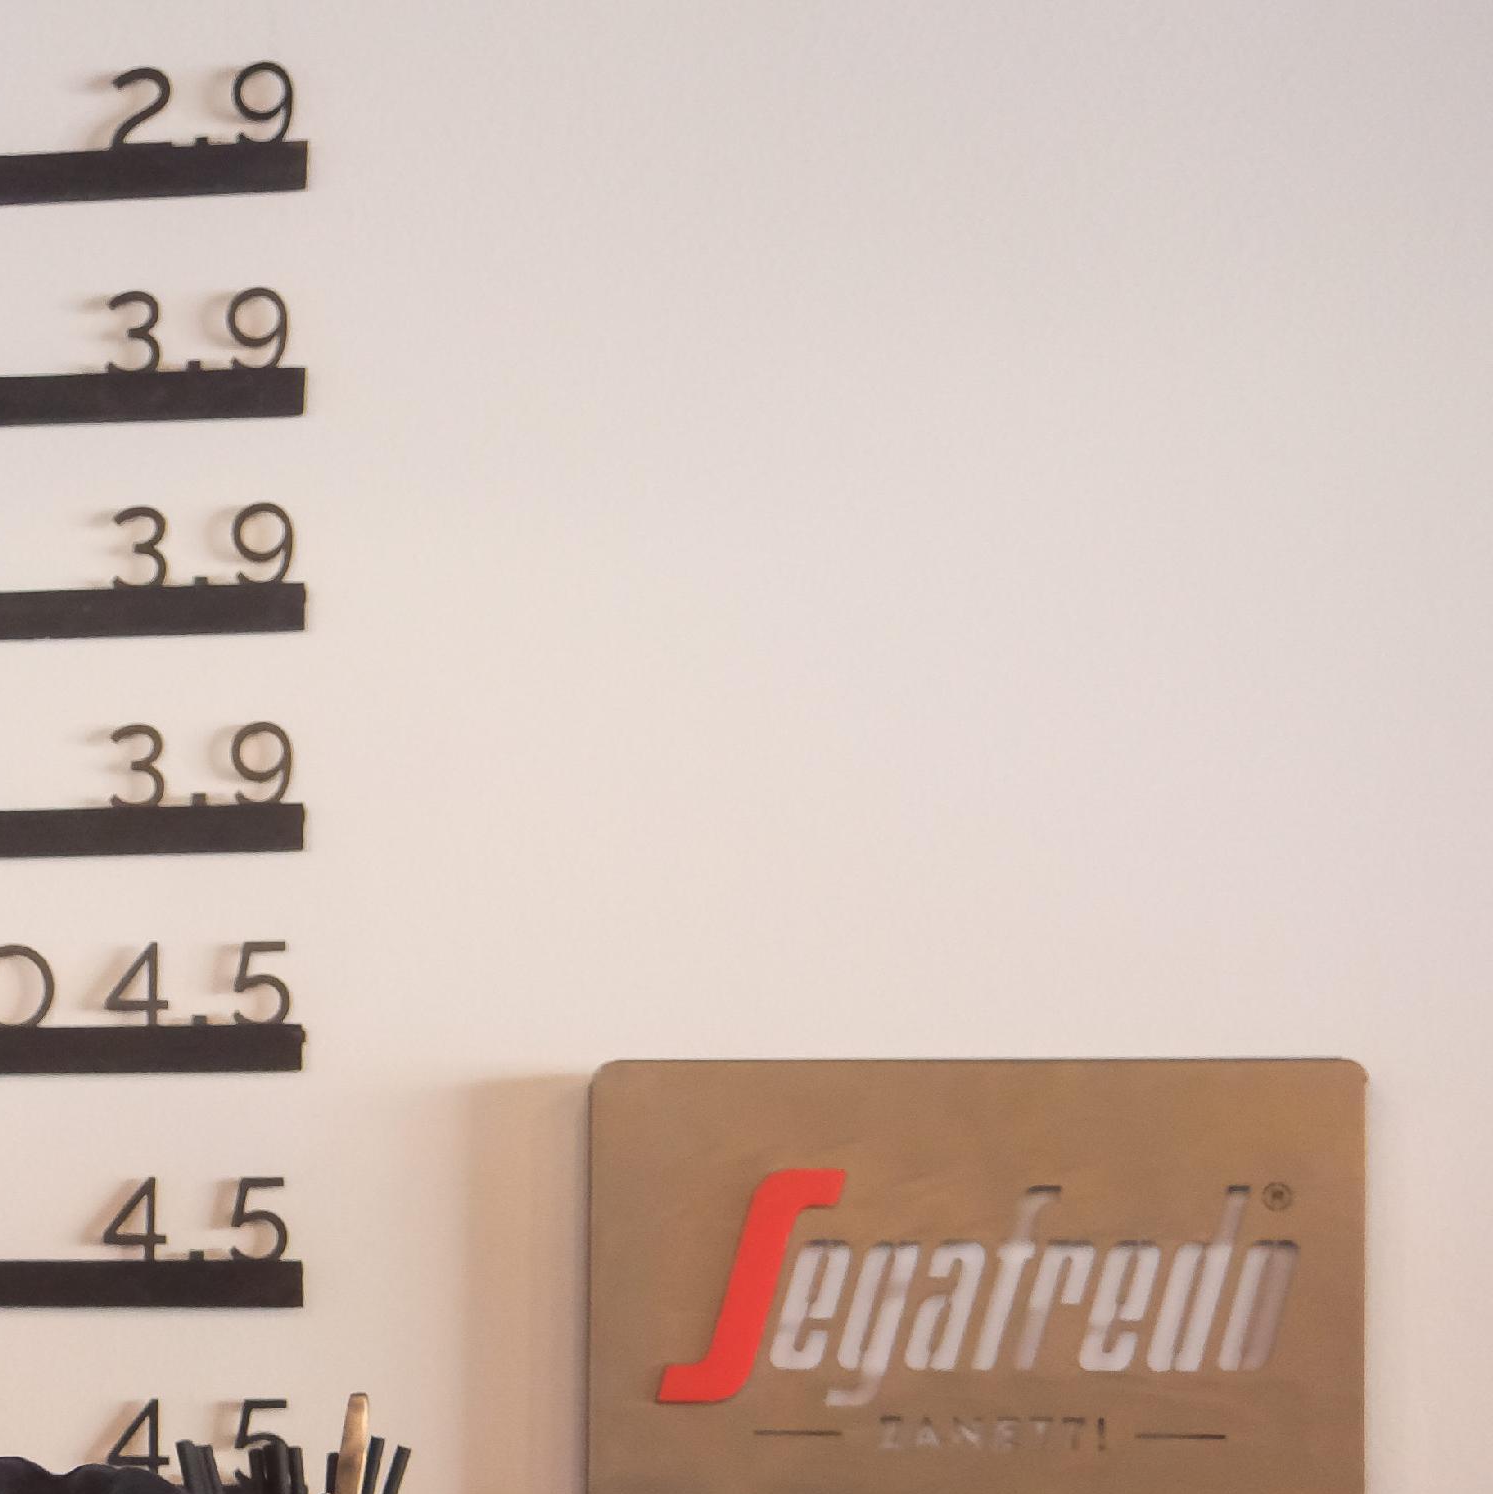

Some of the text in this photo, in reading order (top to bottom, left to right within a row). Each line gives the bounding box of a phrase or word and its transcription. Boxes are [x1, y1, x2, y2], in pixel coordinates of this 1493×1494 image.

[110, 61, 295, 148] 2.9
[106, 287, 289, 373] 3.9
[110, 502, 295, 590] 3.9
[110, 721, 294, 808] 3.9
[103, 940, 293, 1027] 4.5
[102, 1176, 289, 1262] 4.5
[656, 1167, 1301, 1407] Segafredo
